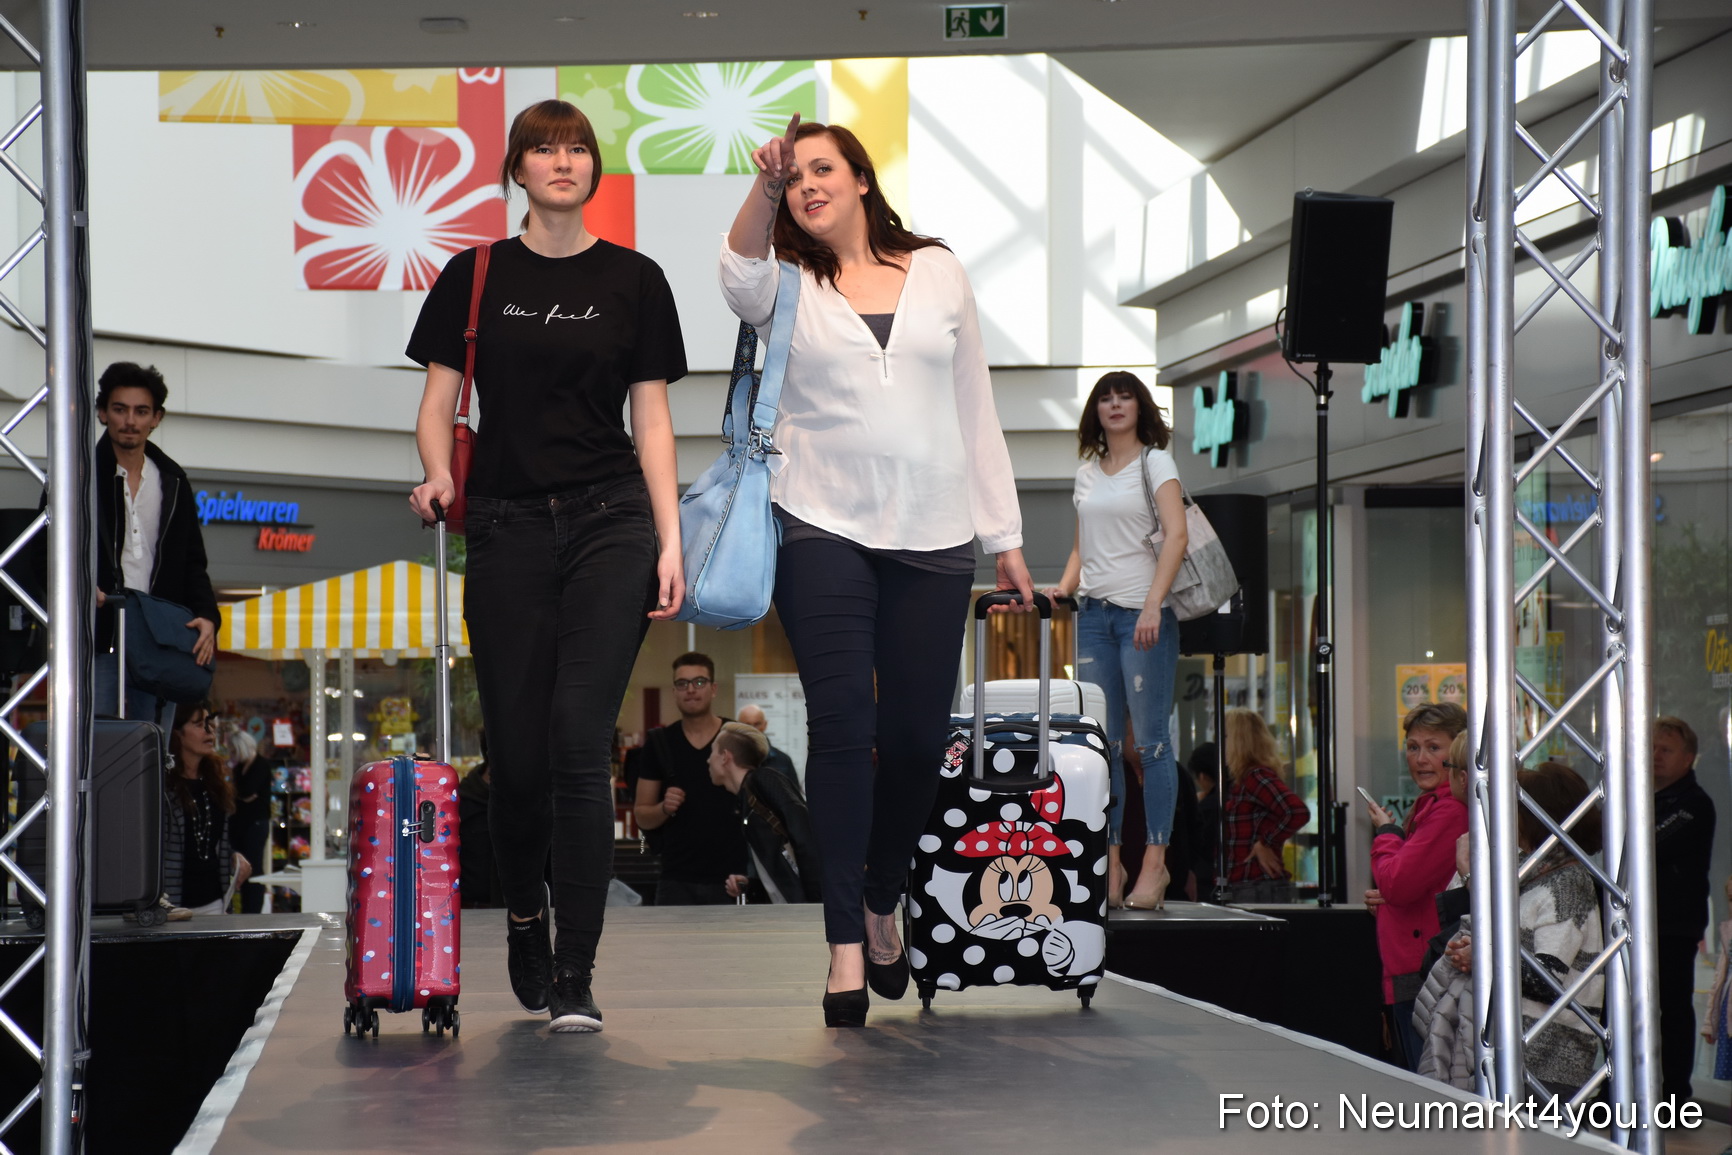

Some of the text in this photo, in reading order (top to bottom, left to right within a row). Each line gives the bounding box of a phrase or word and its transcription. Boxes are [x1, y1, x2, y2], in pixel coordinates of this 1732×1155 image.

[503, 304, 600, 324] We feel
[196, 490, 299, 526] Spielwaren
[258, 527, 315, 552] Krömer
